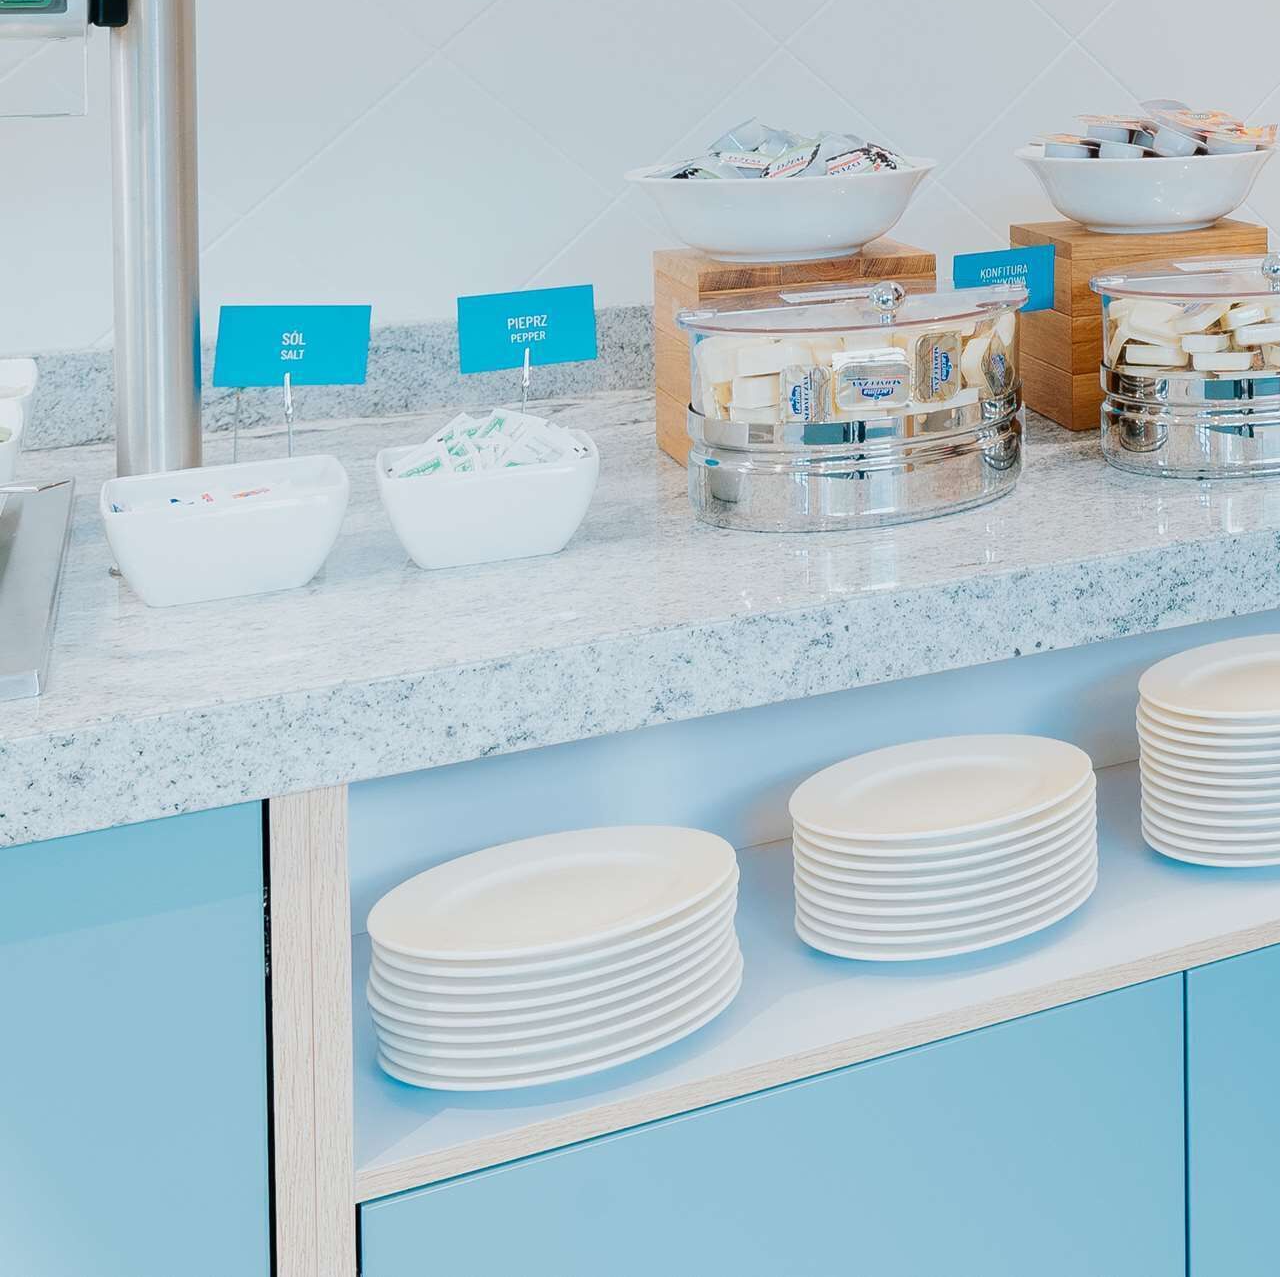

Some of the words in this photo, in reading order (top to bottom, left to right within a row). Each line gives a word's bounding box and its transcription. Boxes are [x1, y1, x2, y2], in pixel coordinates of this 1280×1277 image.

[980, 264, 1028, 280] KONFITURA
[507, 314, 548, 330] PIEPRZ
[282, 330, 306, 345] SÓL
[510, 330, 546, 344] PEPPER
[280, 349, 305, 360] SALT
